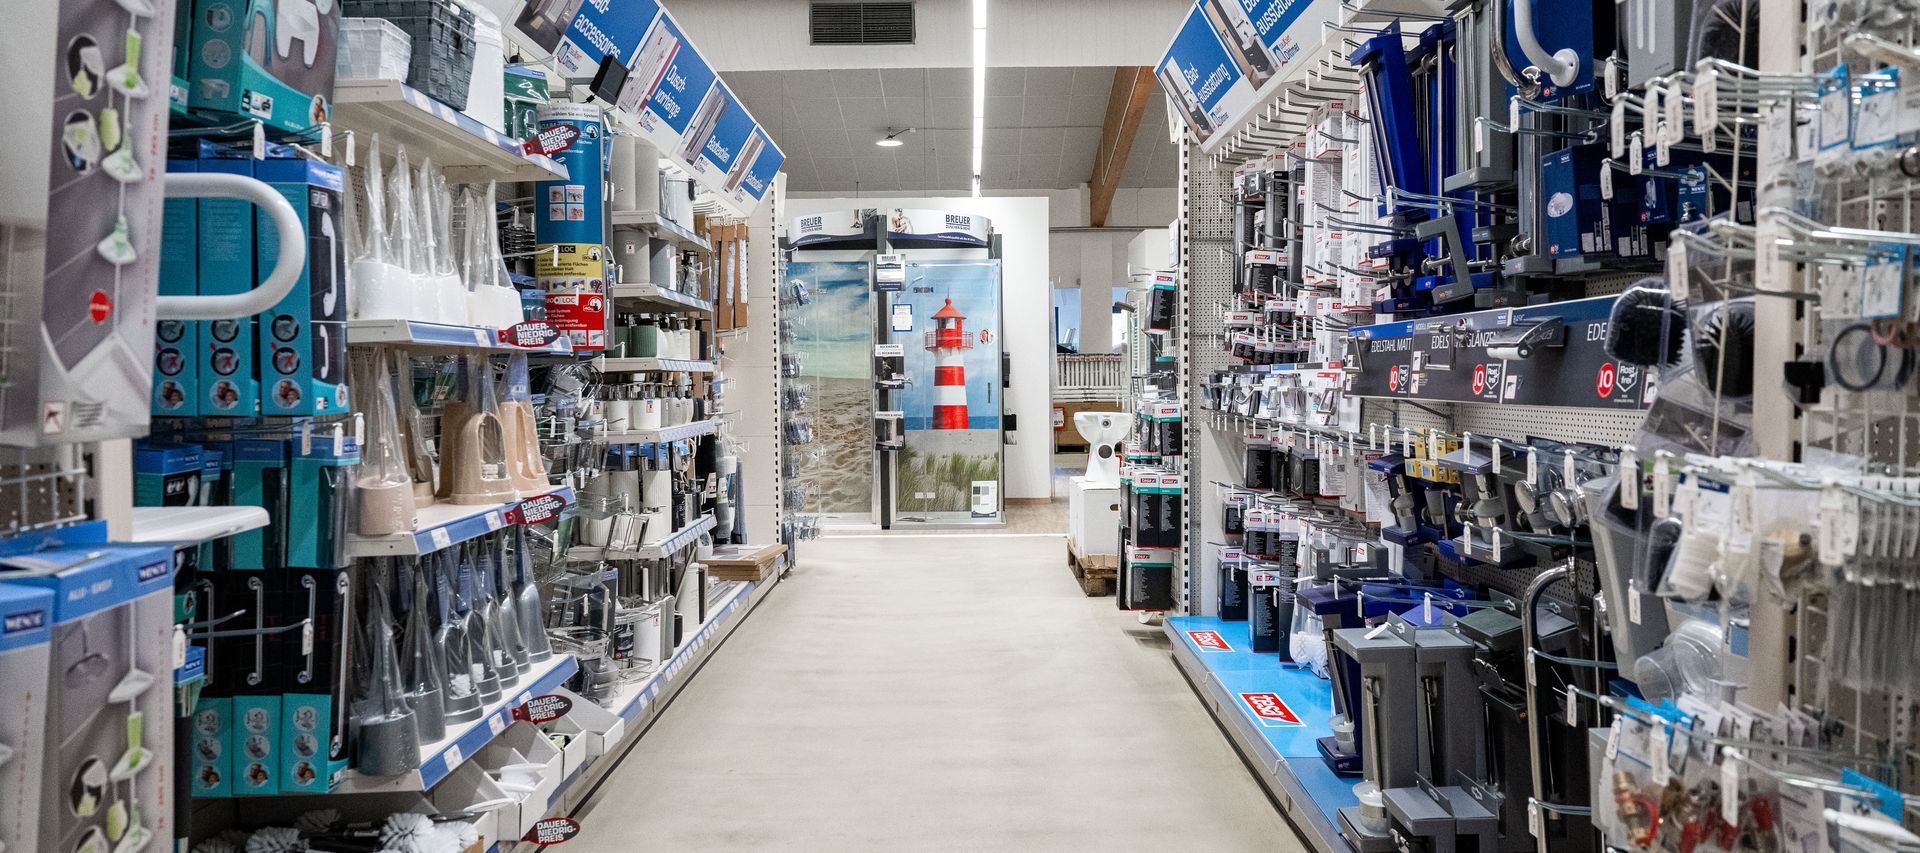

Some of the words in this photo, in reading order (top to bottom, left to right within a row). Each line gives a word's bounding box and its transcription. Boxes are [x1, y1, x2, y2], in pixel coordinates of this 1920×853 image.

[574, 13, 621, 59] accessoires
[666, 64, 687, 93] Dusch-
[1183, 62, 1199, 86] Bad-
[1197, 63, 1232, 104] ausstattung
[654, 88, 681, 119] vorhänge
[538, 126, 569, 141] DAUER-
[540, 130, 577, 147] NIEDRIG-
[542, 140, 568, 154] PREIS
[801, 216, 822, 228] BREUER
[945, 214, 971, 225] BREUER
[516, 322, 549, 332] DAUER-
[517, 329, 557, 338] NIEDRIG-
[518, 337, 544, 346] PREIS
[1371, 338, 1395, 353] EDELSTAHL
[1395, 337, 1412, 351] MATT
[1620, 365, 1635, 374] Rost
[1621, 376, 1632, 385] frei
[521, 496, 554, 510] DAUER-
[523, 501, 563, 517] NIEDRIG-
[525, 510, 552, 524] PREIS
[527, 696, 560, 708] DAUER-
[529, 702, 568, 715] NIEDRIG-
[1249, 695, 1285, 717] tesa
[530, 710, 556, 722] PREIS
[536, 819, 569, 830] DAUER-
[537, 825, 577, 837] NIEDRIG-
[538, 833, 565, 844] PREIS
